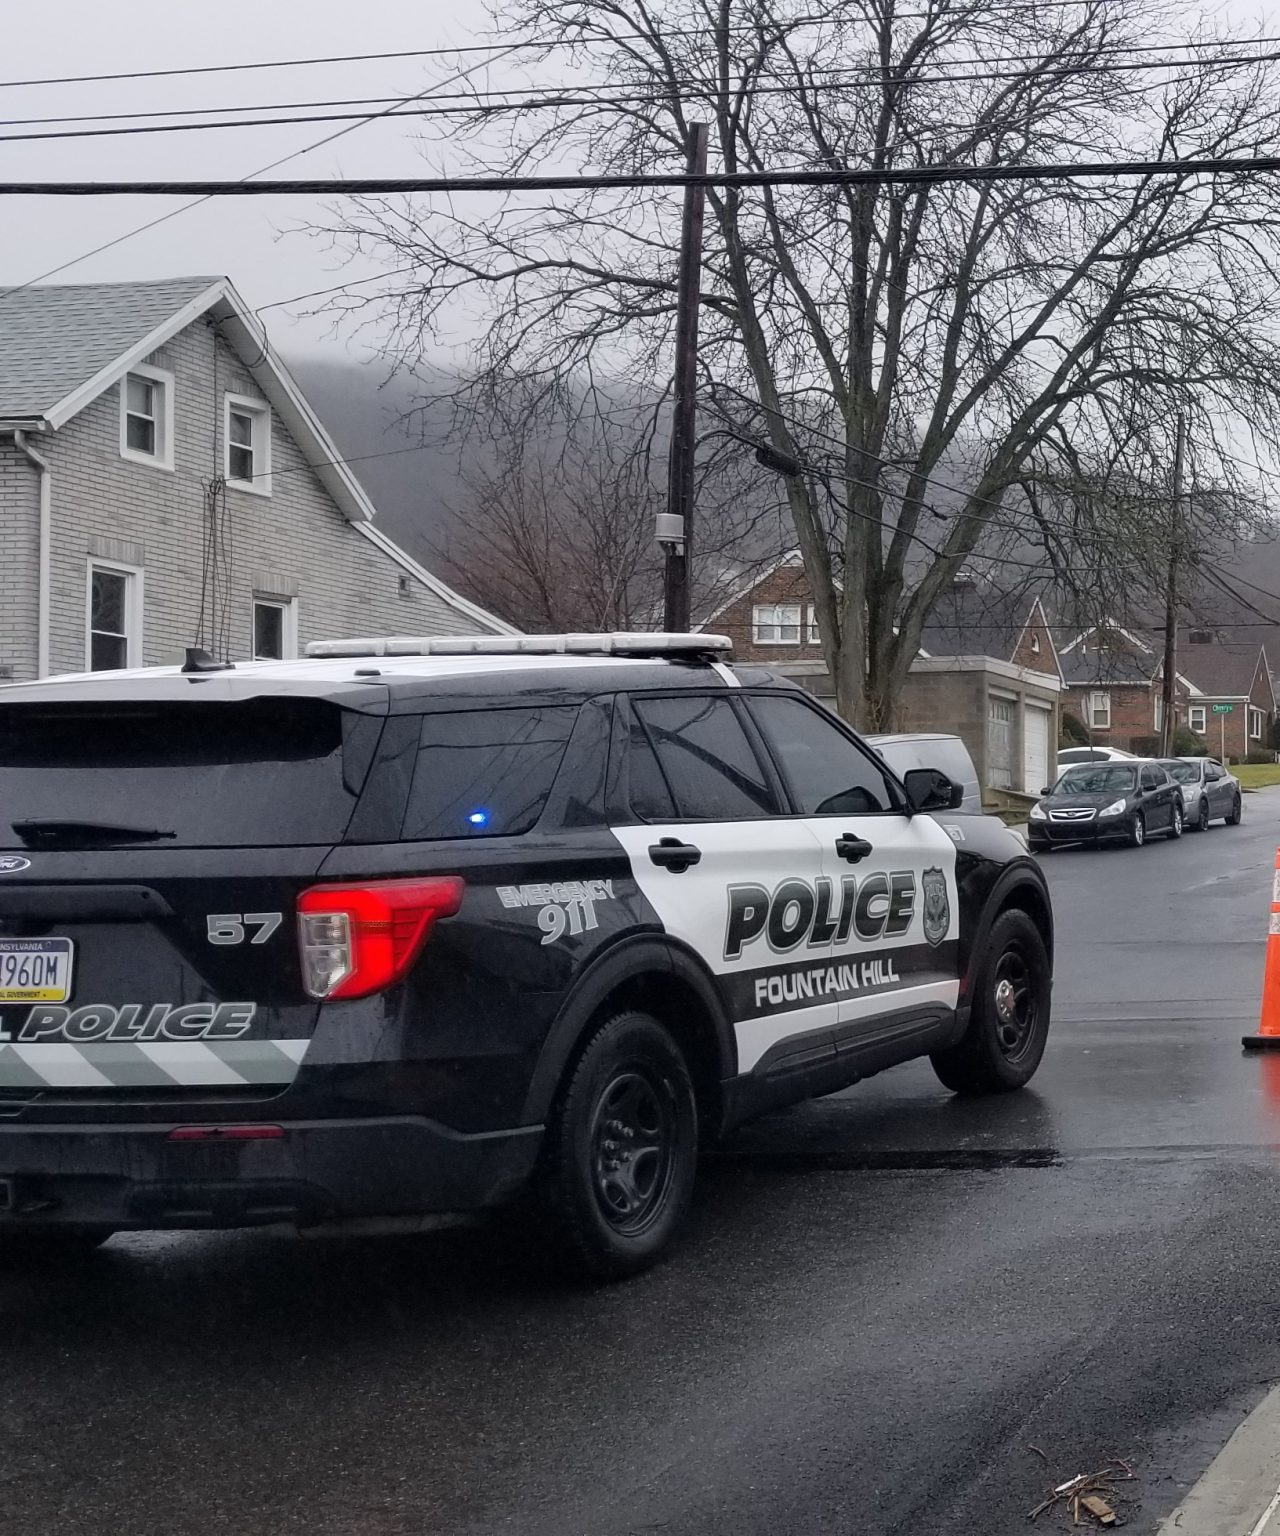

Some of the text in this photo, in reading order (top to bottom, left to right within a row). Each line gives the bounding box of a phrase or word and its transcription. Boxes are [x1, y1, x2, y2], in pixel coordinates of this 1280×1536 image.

[496, 879, 615, 909] EMERGENCY
[724, 870, 915, 962] POLICE
[206, 912, 282, 945] 57
[537, 894, 599, 945] 911
[754, 958, 900, 1008] FOUNTAIN HILL
[18, 1002, 256, 1042] POLICE
